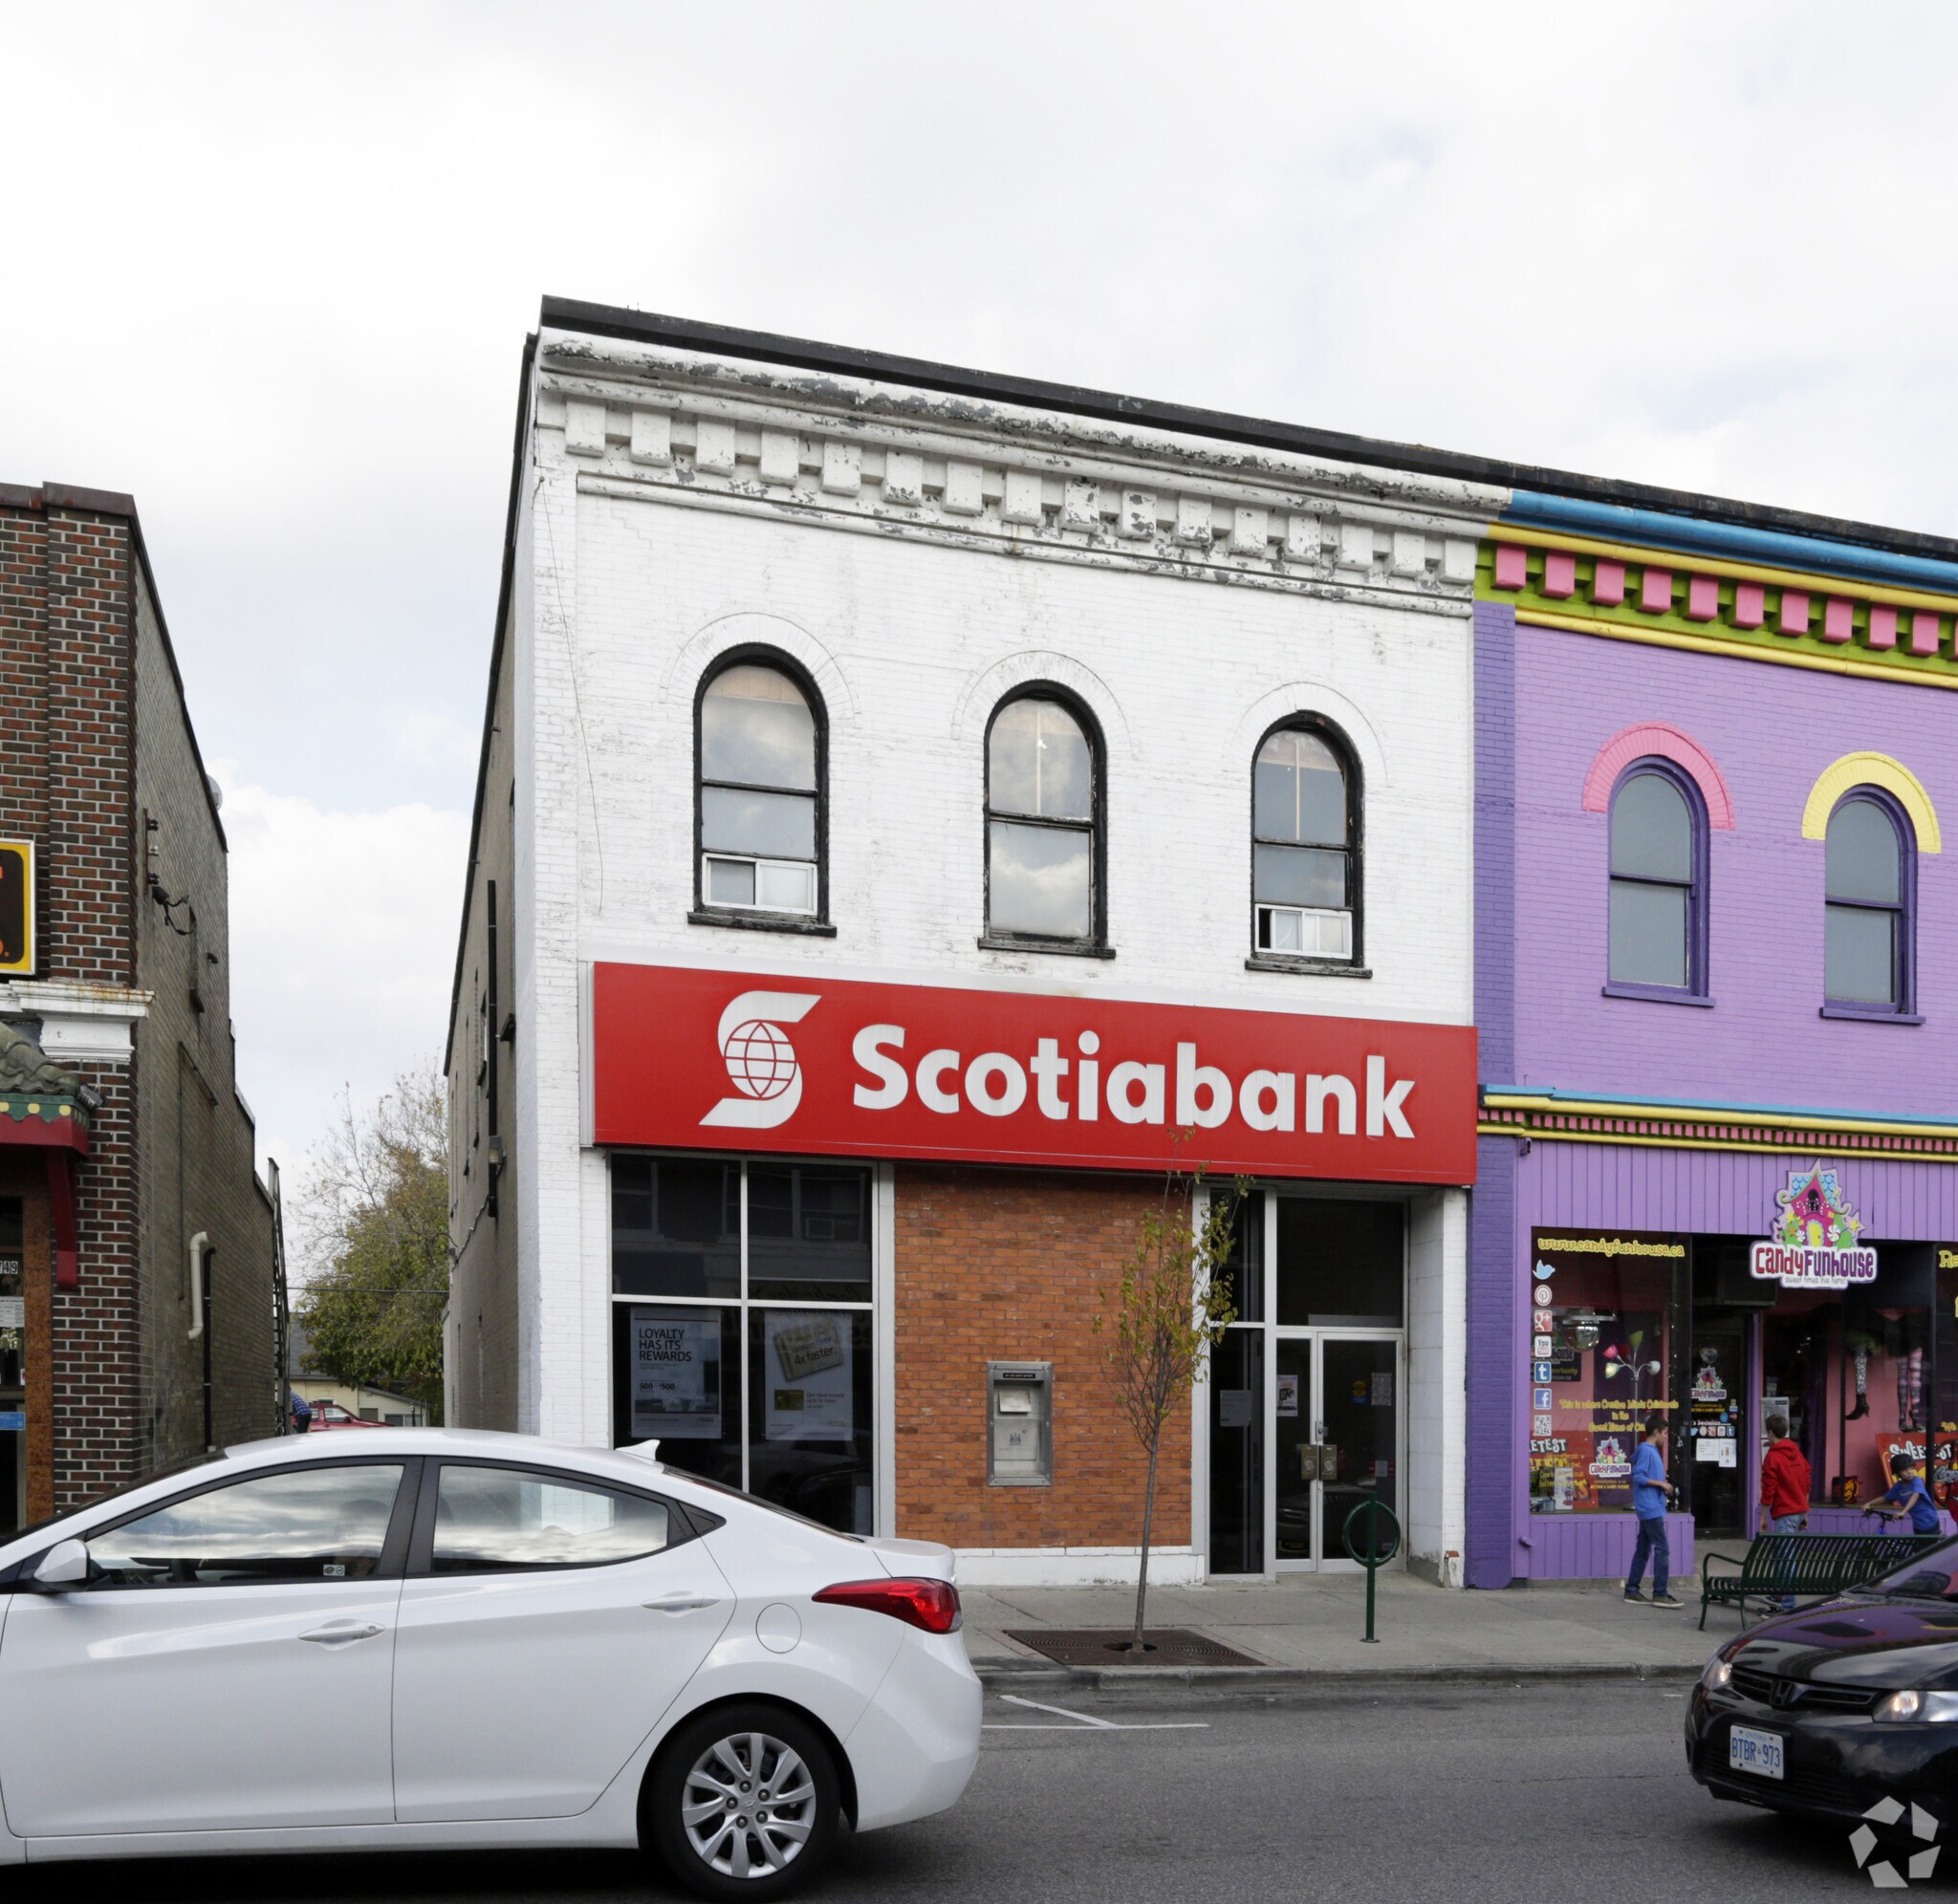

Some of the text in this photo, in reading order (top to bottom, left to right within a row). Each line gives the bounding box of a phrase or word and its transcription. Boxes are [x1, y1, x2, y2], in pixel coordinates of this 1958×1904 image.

[852, 1023, 1417, 1139] Scotiabank
[1537, 1238, 1685, 1257] www.candyfunhouse.ca
[639, 1328, 685, 1339] LOYALTY
[639, 1340, 681, 1351] HAS ITS
[639, 1351, 692, 1362] REWARDS
[1530, 1438, 1567, 1453] ETEST
[1731, 1737, 1781, 1767] BTBR 973
